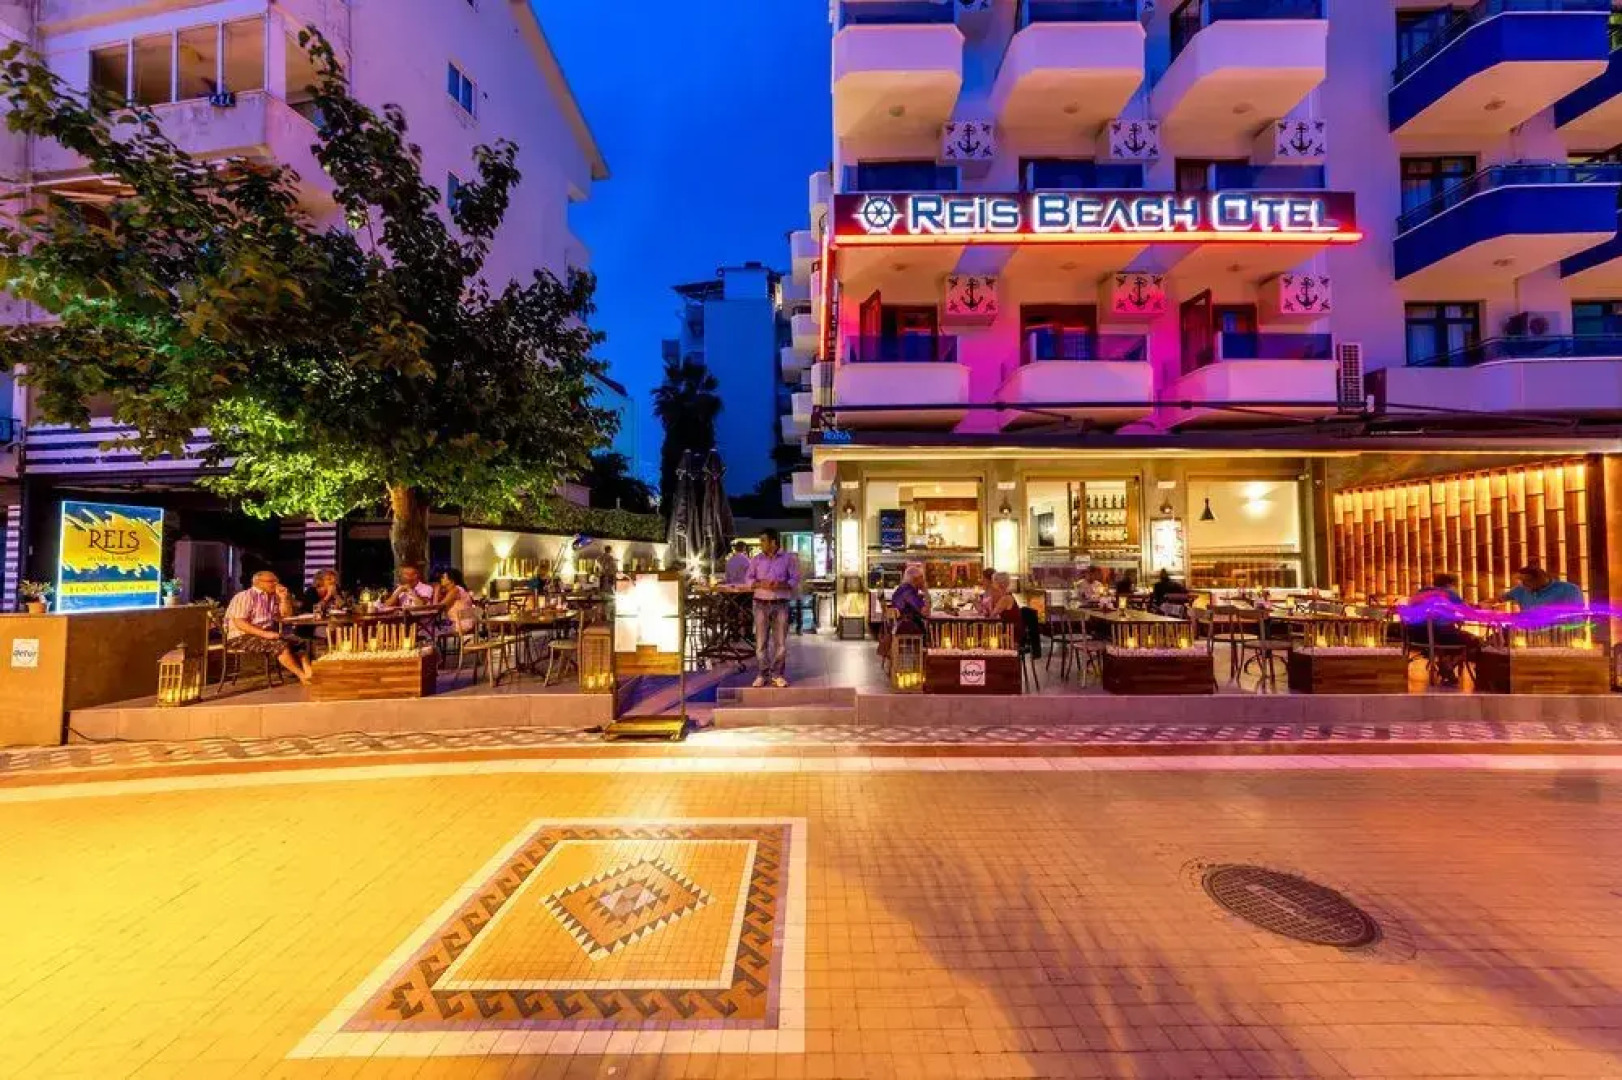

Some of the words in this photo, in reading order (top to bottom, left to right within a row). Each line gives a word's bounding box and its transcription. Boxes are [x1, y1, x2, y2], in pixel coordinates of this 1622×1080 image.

[1035, 193, 1199, 232] BEACH
[1213, 193, 1339, 231] OTEL
[88, 529, 140, 554] REIS
